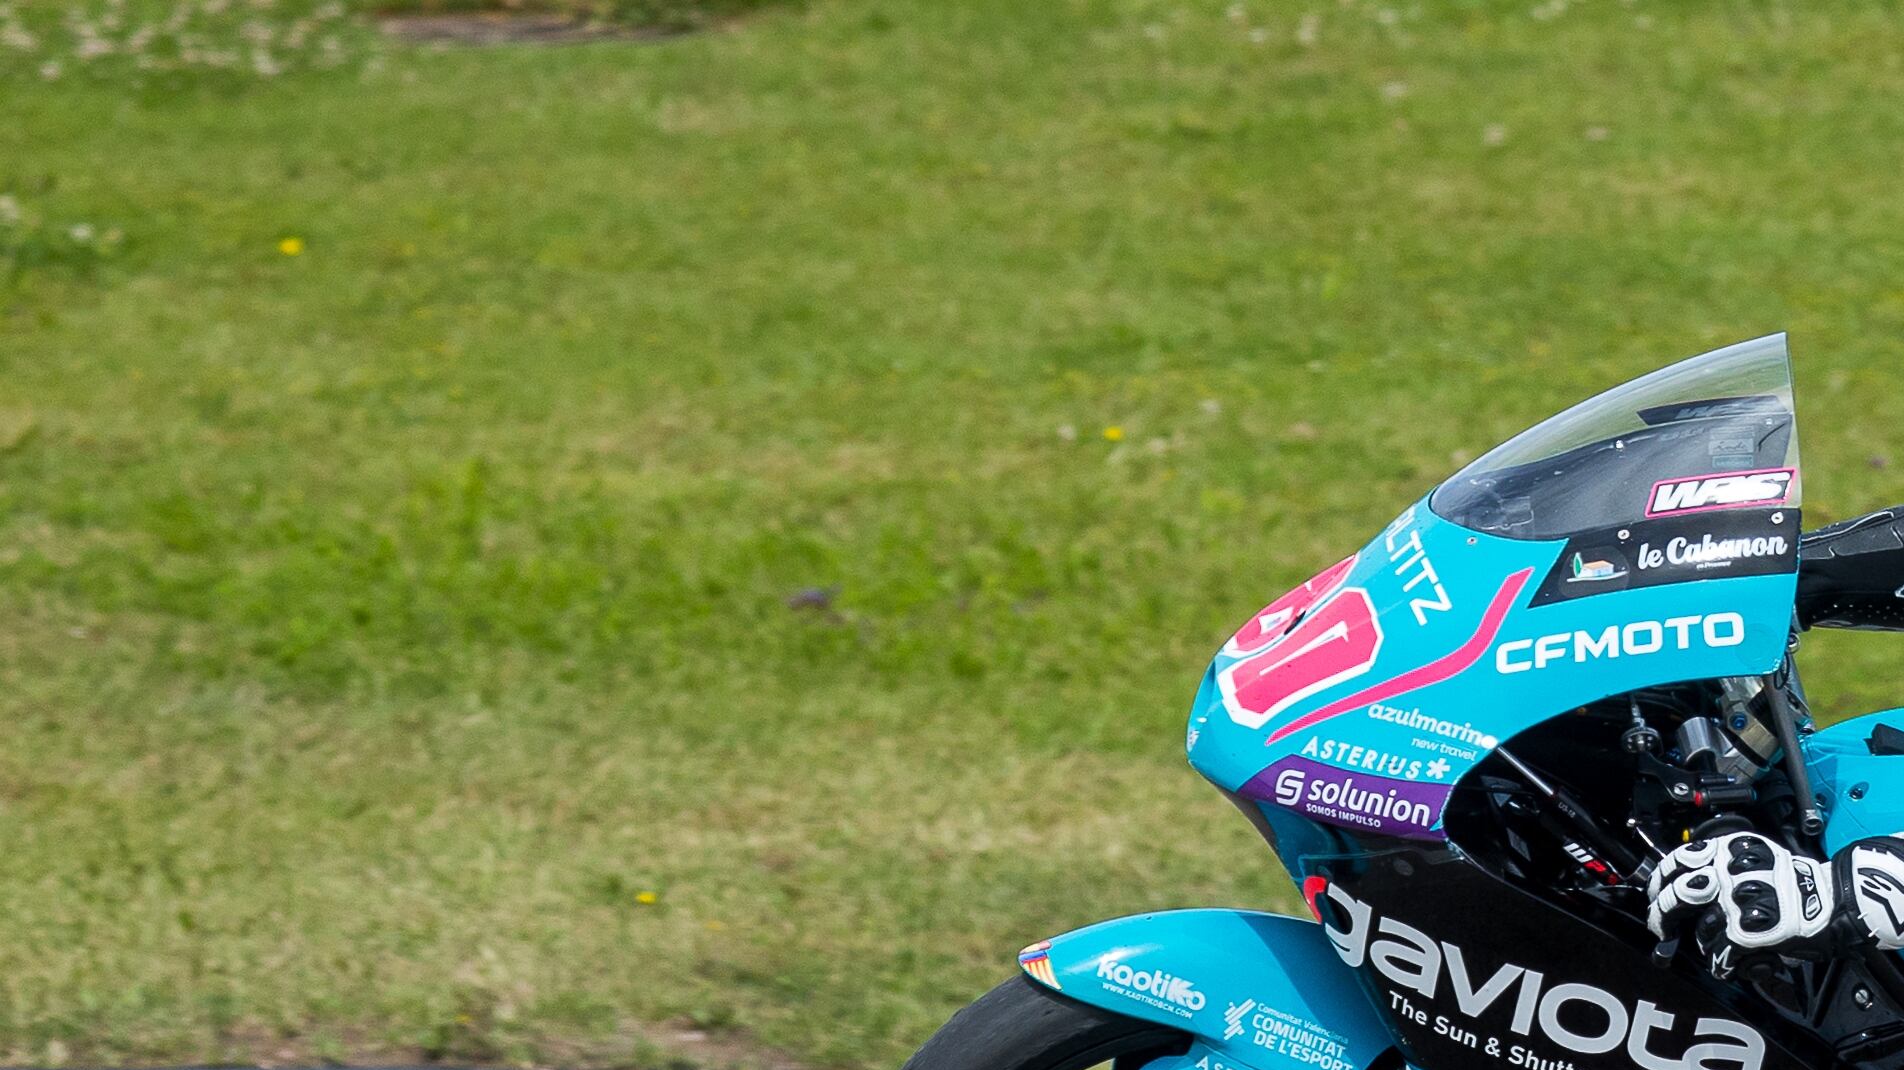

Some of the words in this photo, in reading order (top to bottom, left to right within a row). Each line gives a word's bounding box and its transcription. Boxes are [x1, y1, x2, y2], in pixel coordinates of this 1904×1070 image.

[1637, 543, 1664, 570] le
[1666, 534, 1788, 565] Cabanon
[1496, 612, 1745, 675] CFMOTO
[1367, 703, 1498, 749] azulmarino
[1411, 737, 1437, 753] new
[1439, 741, 1478, 762] travel
[1306, 803, 1337, 818] SOMOS
[1338, 810, 1382, 828] IMPULSO
[1307, 778, 1431, 828] solunion
[1258, 1003, 1302, 1026] Comunitat
[1389, 991, 1428, 1027] The
[1433, 1015, 1478, 1050] Sun
[1484, 1036, 1502, 1058] &
[1252, 1013, 1346, 1058] COMUNITAT
[1253, 1030, 1278, 1050] DE
